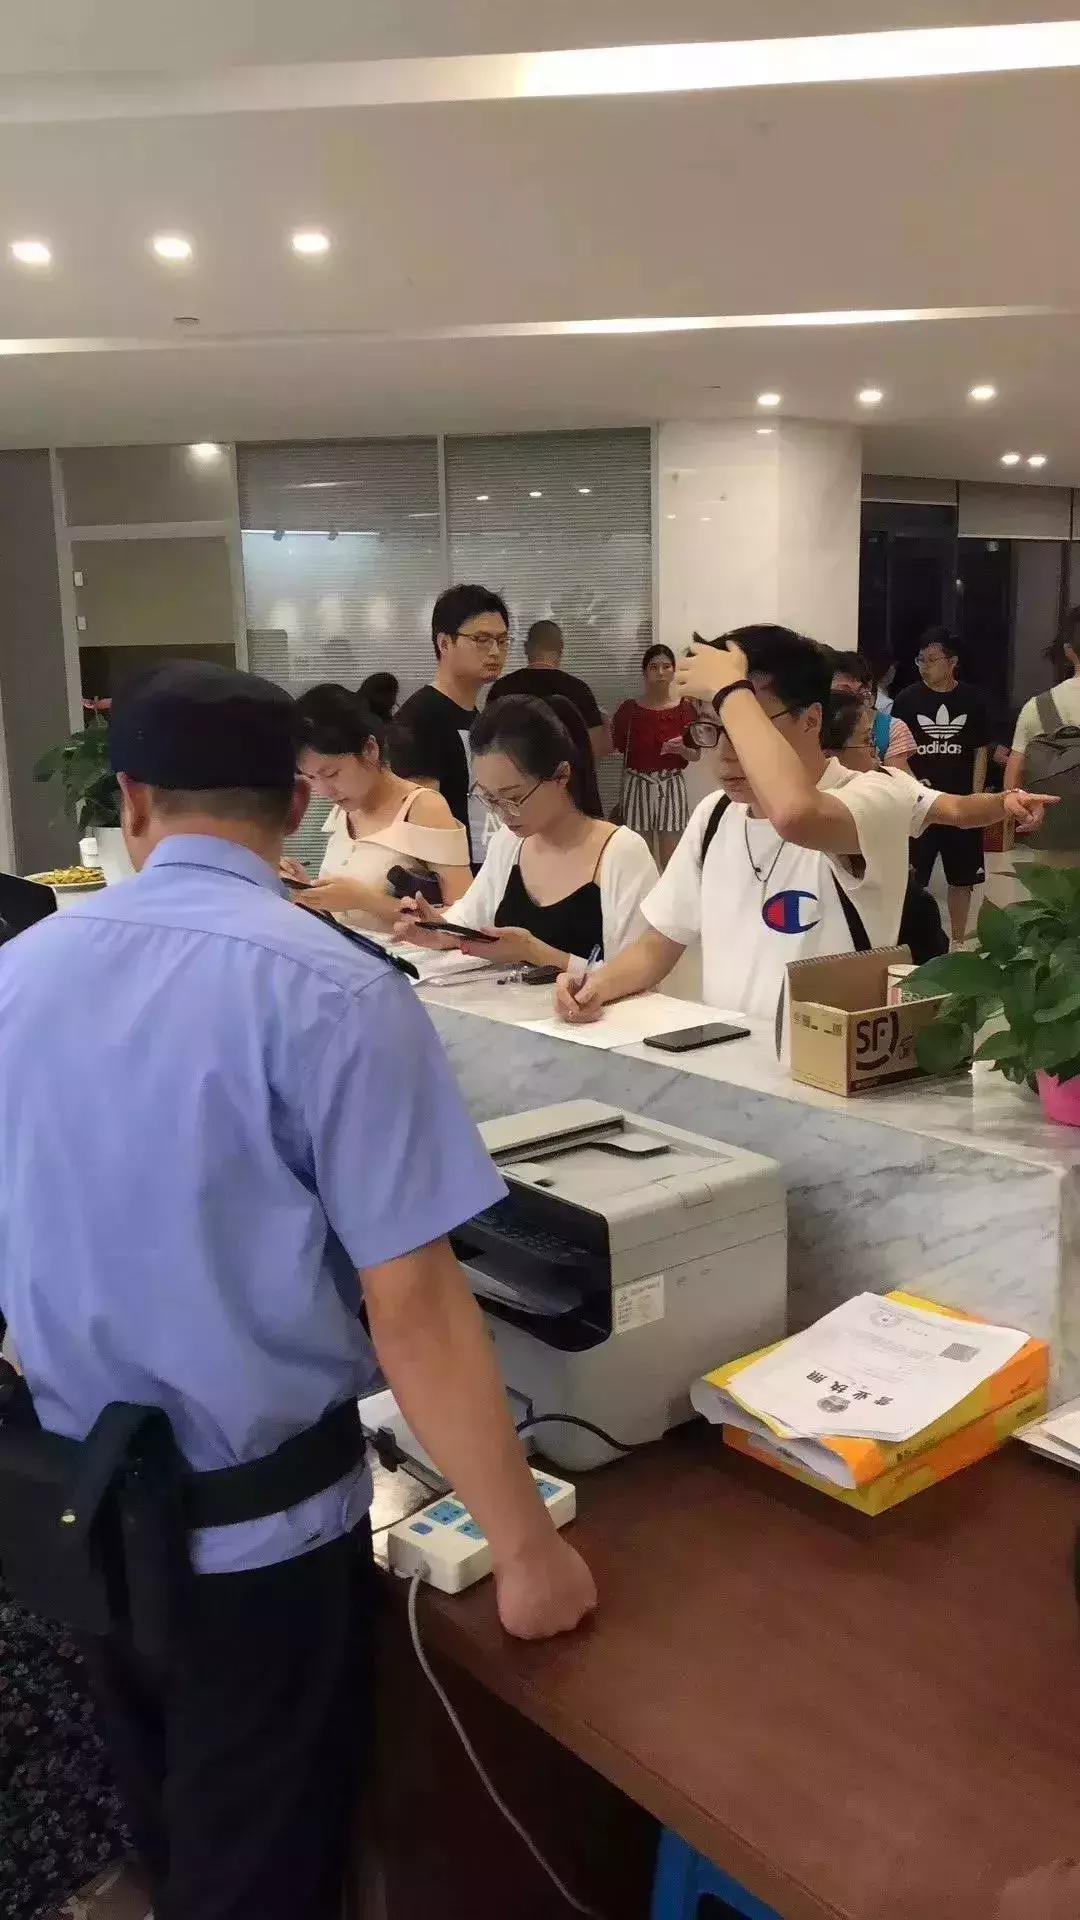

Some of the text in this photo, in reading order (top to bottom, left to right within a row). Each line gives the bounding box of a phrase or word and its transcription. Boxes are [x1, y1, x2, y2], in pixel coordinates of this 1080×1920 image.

[917, 741, 962, 755] adidas
[806, 1370, 894, 1407] 营业执照
